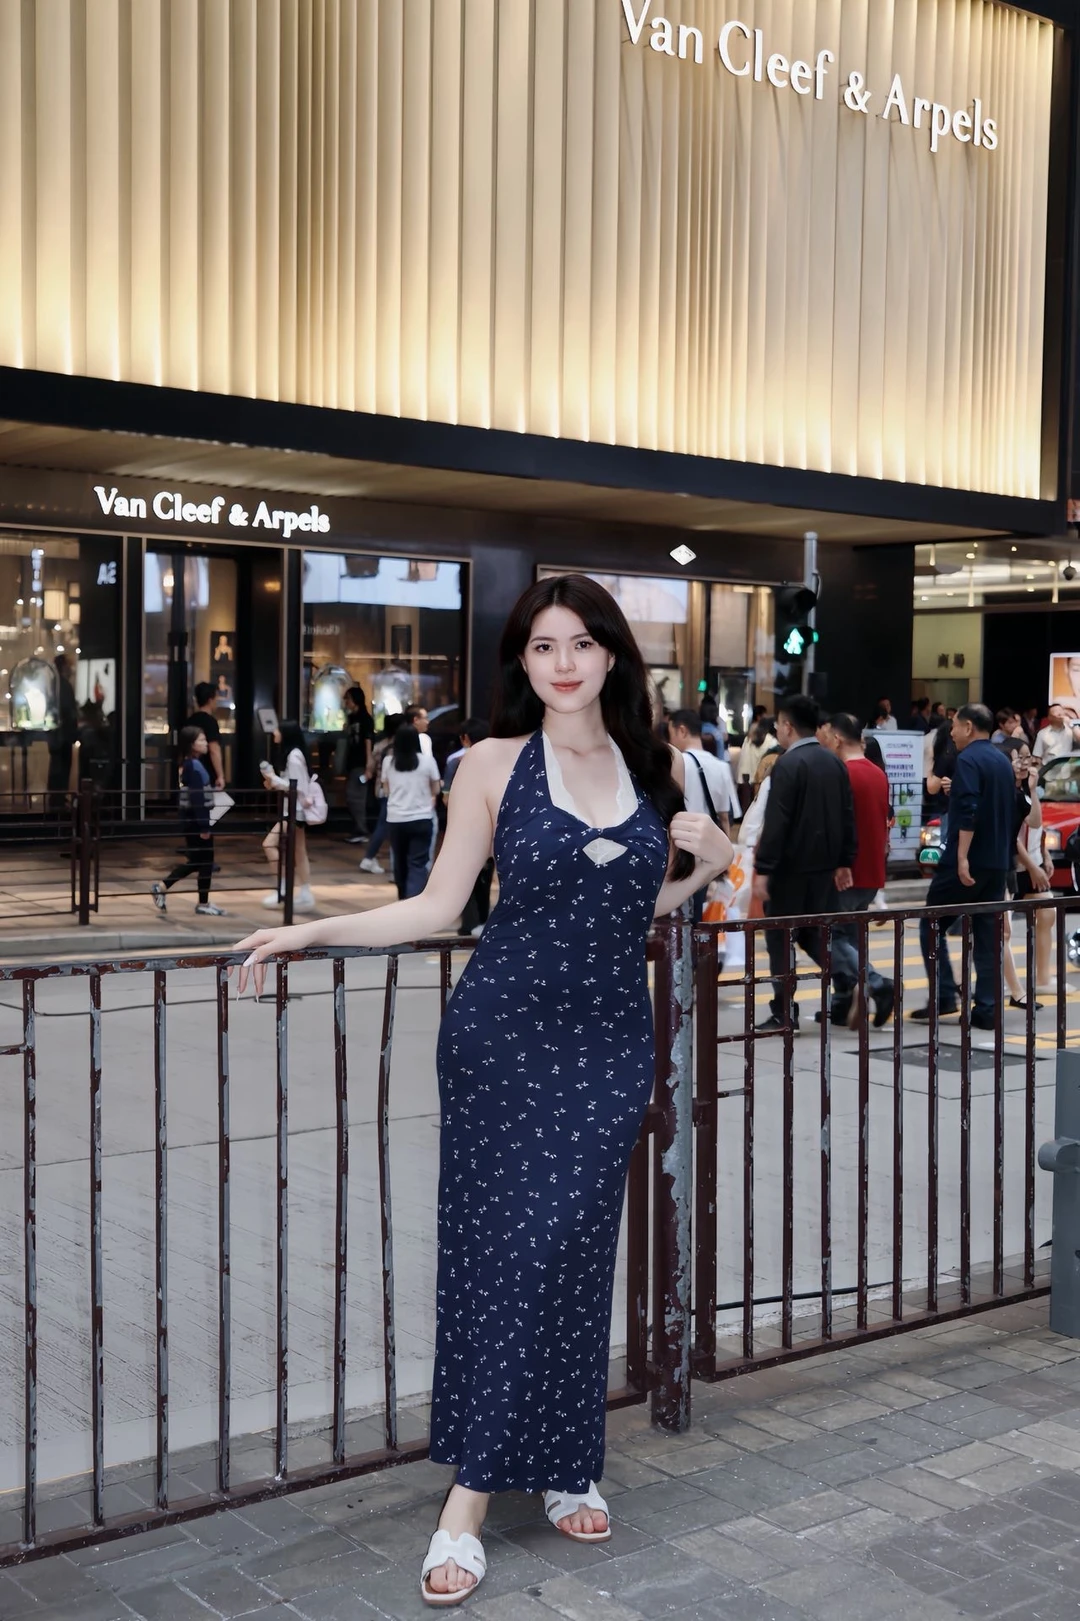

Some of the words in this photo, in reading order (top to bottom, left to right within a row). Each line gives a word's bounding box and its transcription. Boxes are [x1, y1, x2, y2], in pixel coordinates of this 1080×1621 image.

[621, 0, 703, 64] Van
[718, 20, 835, 100] Cleef
[844, 71, 872, 114] &
[881, 73, 998, 153] Arpels
[94, 486, 147, 519] Van
[153, 491, 226, 525] Cleef
[228, 503, 249, 527] &
[252, 500, 331, 538] Arpels
